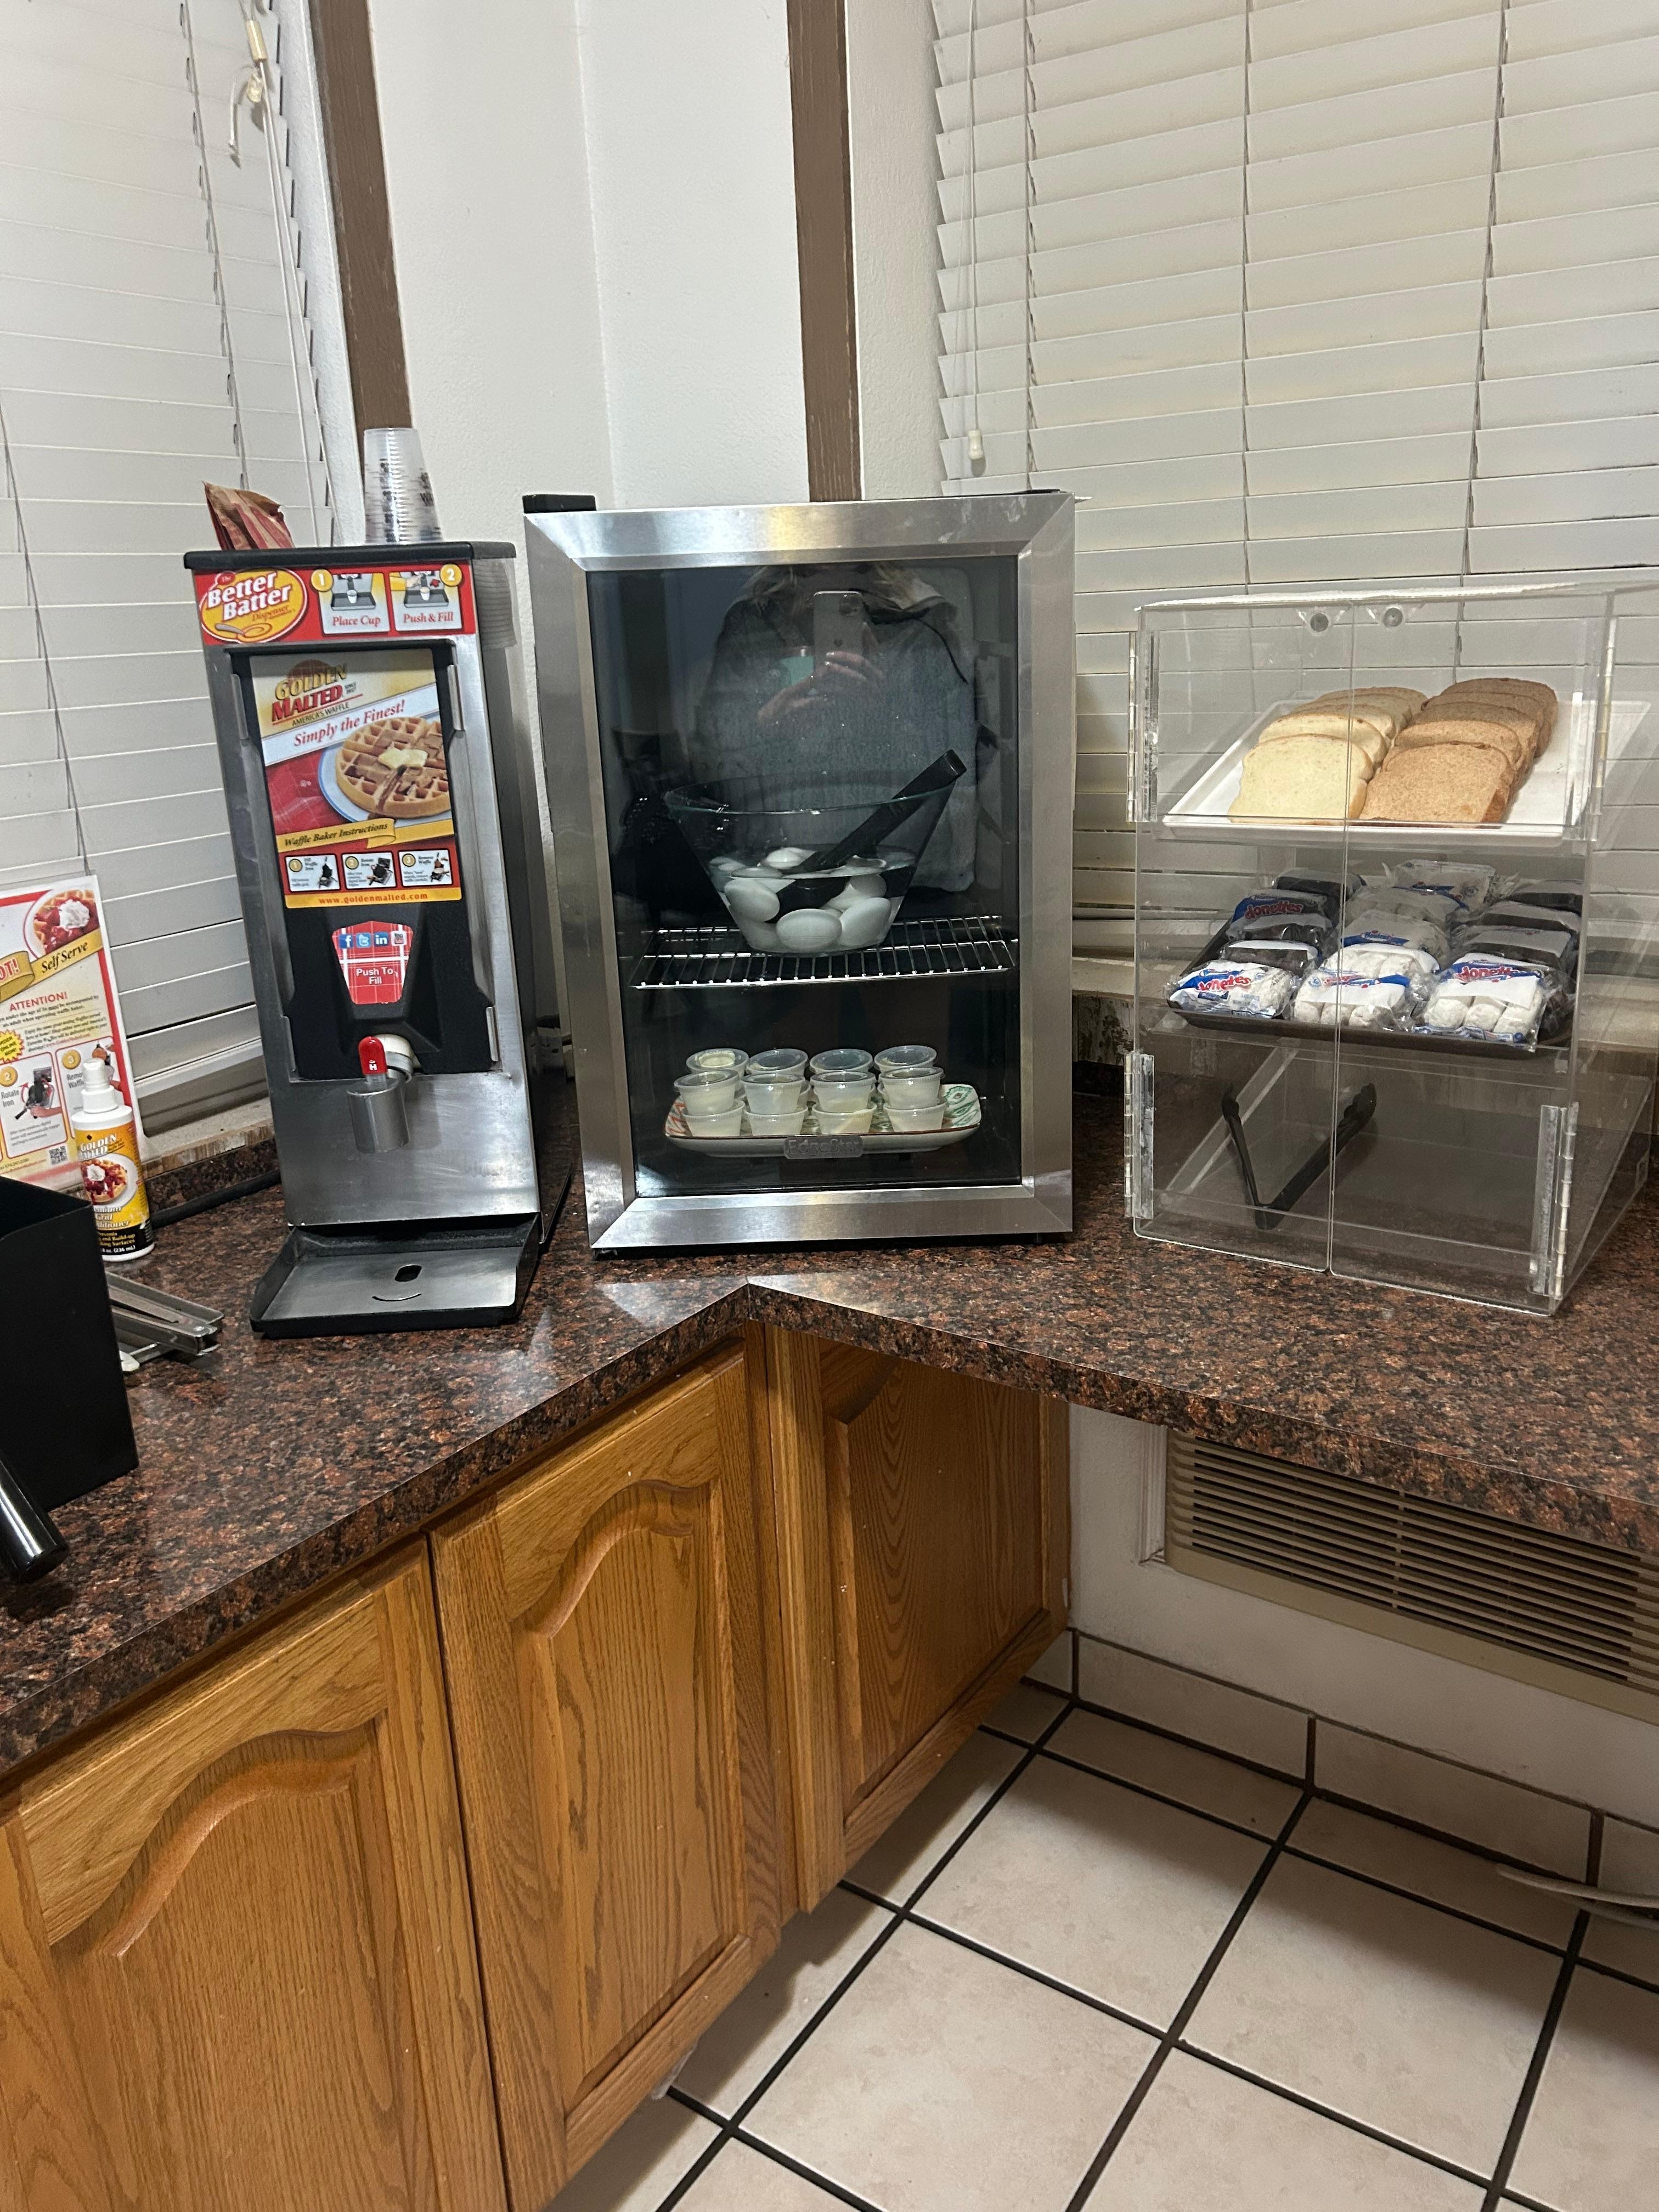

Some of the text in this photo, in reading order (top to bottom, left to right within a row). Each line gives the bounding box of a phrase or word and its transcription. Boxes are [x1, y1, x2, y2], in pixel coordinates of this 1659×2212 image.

[320, 573, 325, 586] 1
[447, 568, 455, 581] 2
[207, 572, 277, 608] Better
[223, 585, 291, 620] Batter
[252, 605, 290, 622] Dispenser
[332, 615, 381, 627] Place Cup
[403, 612, 454, 623] Push & Fill
[275, 663, 347, 700] GOLDEN
[272, 685, 343, 722] MALTED
[292, 702, 349, 726] AMERICA'S WAFFLE
[294, 699, 405, 747] Simply the Finest!
[285, 823, 388, 846] Waffle Baker Instructions
[318, 893, 428, 904] www.goldenmalted.com
[1245, 900, 1303, 920] donettes
[42, 941, 88, 973] Self Serve
[356, 967, 394, 977] Push To
[369, 976, 382, 985] Fill
[1457, 966, 1519, 983] donett
[9, 991, 67, 1012] ATTENTION!
[67, 1072, 82, 1081] Remo
[69, 1080, 84, 1089] Waffl
[1, 1089, 19, 1099] Rotate
[3, 1099, 14, 1108] Iron
[81, 1133, 116, 1152] GOLDEN
